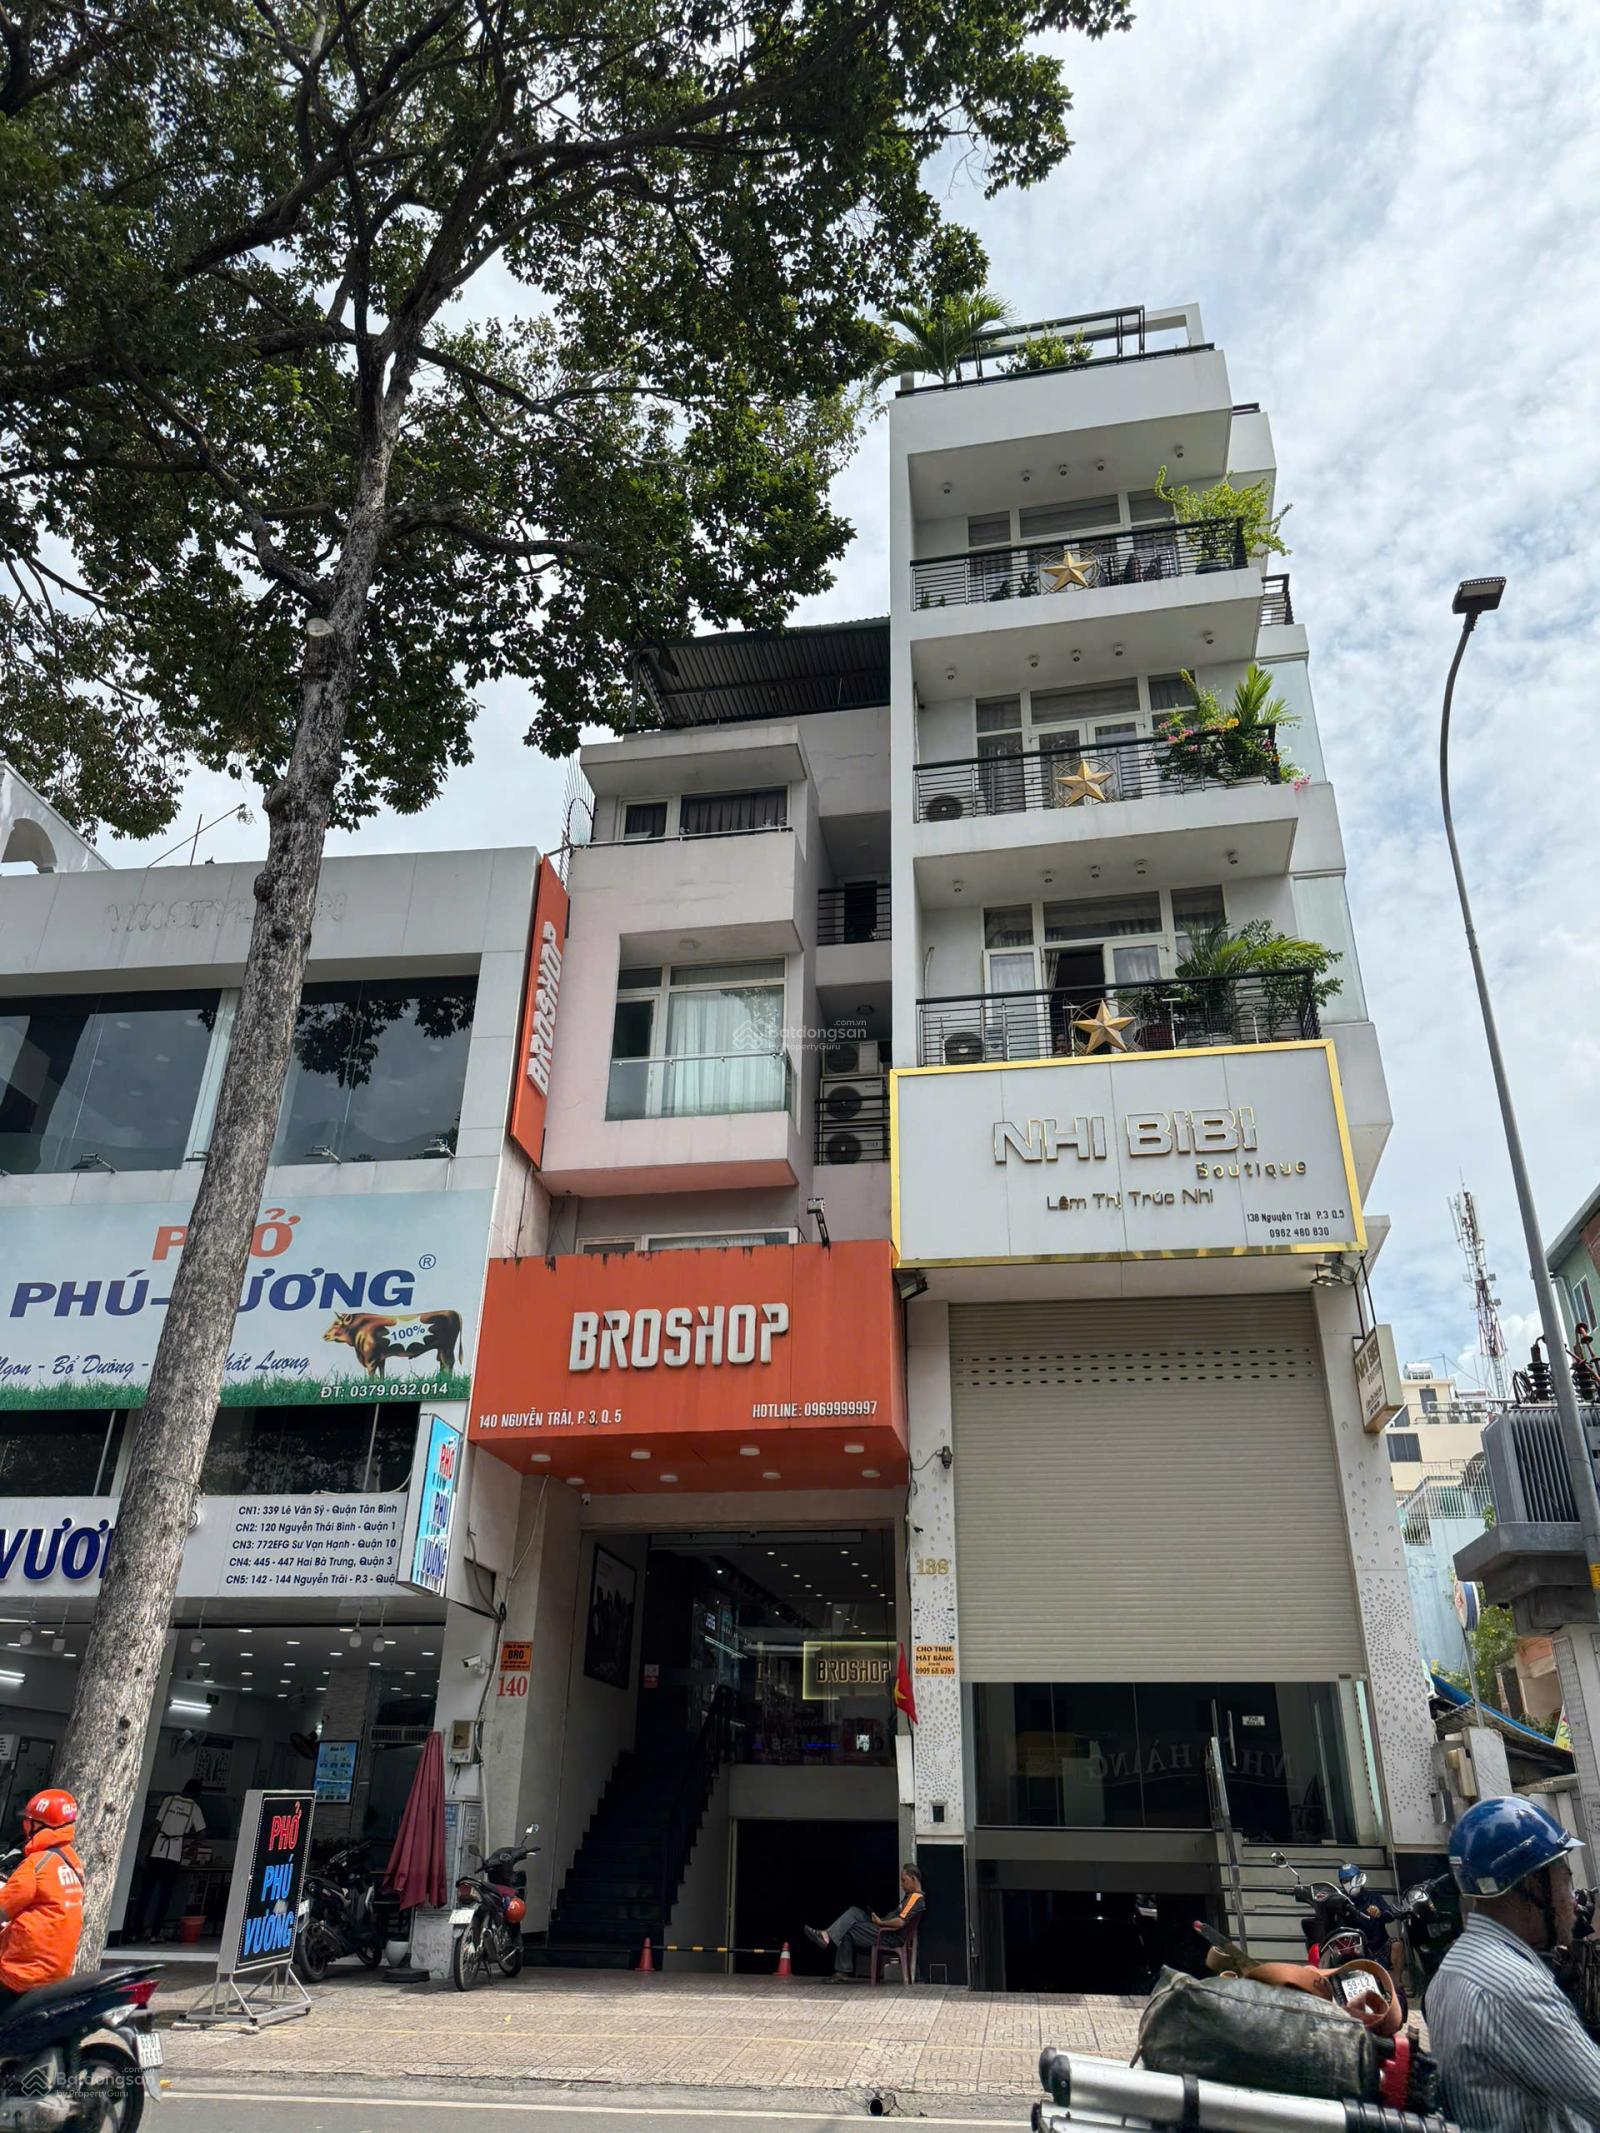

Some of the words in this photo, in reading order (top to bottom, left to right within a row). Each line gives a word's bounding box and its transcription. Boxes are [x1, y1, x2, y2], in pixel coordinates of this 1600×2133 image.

[527, 921, 562, 1097] BROSHOP
[993, 1115, 1107, 1164] NHI
[1182, 1188, 1213, 1205] Nhi
[1246, 1213, 1259, 1223] 138
[1316, 1210, 1329, 1220] P.3
[152, 1208, 301, 1260] PỞ
[390, 1325, 426, 1341] 100%
[568, 1302, 789, 1373] BROSHOP
[224, 1352, 252, 1371] hất
[320, 1386, 344, 1398] ĐT:
[350, 1382, 448, 1398] 0379.032.014
[480, 1413, 498, 1428] 140
[501, 1407, 543, 1427] NGUYỄN
[752, 1402, 802, 1418] HOTLINE:
[804, 1400, 877, 1416] 0969999997
[239, 1506, 260, 1515] CN1:
[263, 1505, 279, 1515] 339
[281, 1505, 291, 1514] Lê
[294, 1505, 312, 1514] Văn
[332, 1504, 357, 1516] Quận
[359, 1504, 375, 1513] Tân
[235, 1522, 258, 1532] CN2:
[261, 1522, 277, 1532] 120
[278, 1520, 313, 1534] Nguyễn
[315, 1522, 334, 1531] Thái
[363, 1521, 389, 1533] Quận
[0, 1518, 115, 1580] VƯƠ
[232, 1540, 255, 1549] CN3:
[257, 1540, 290, 1549] 772EFG
[306, 1540, 323, 1552] Vạn
[326, 1539, 350, 1551] Hạnh
[357, 1538, 383, 1550] Quận
[386, 1539, 397, 1548] 10
[229, 1557, 252, 1567] CN4:
[253, 1557, 271, 1567] 445
[277, 1557, 295, 1566] 447
[296, 1557, 313, 1566] Hai
[359, 1555, 384, 1568] Quận
[226, 1574, 249, 1584] CN5:
[251, 1574, 268, 1584] 142
[275, 1574, 292, 1584] 144
[355, 1574, 368, 1583] P.3
[375, 1573, 396, 1586] Quậ
[816, 1658, 891, 1683] BROSHOP
[496, 1675, 528, 1697] 140
[268, 1801, 302, 1851] PHỞ
[261, 1853, 294, 1902] PHÚ
